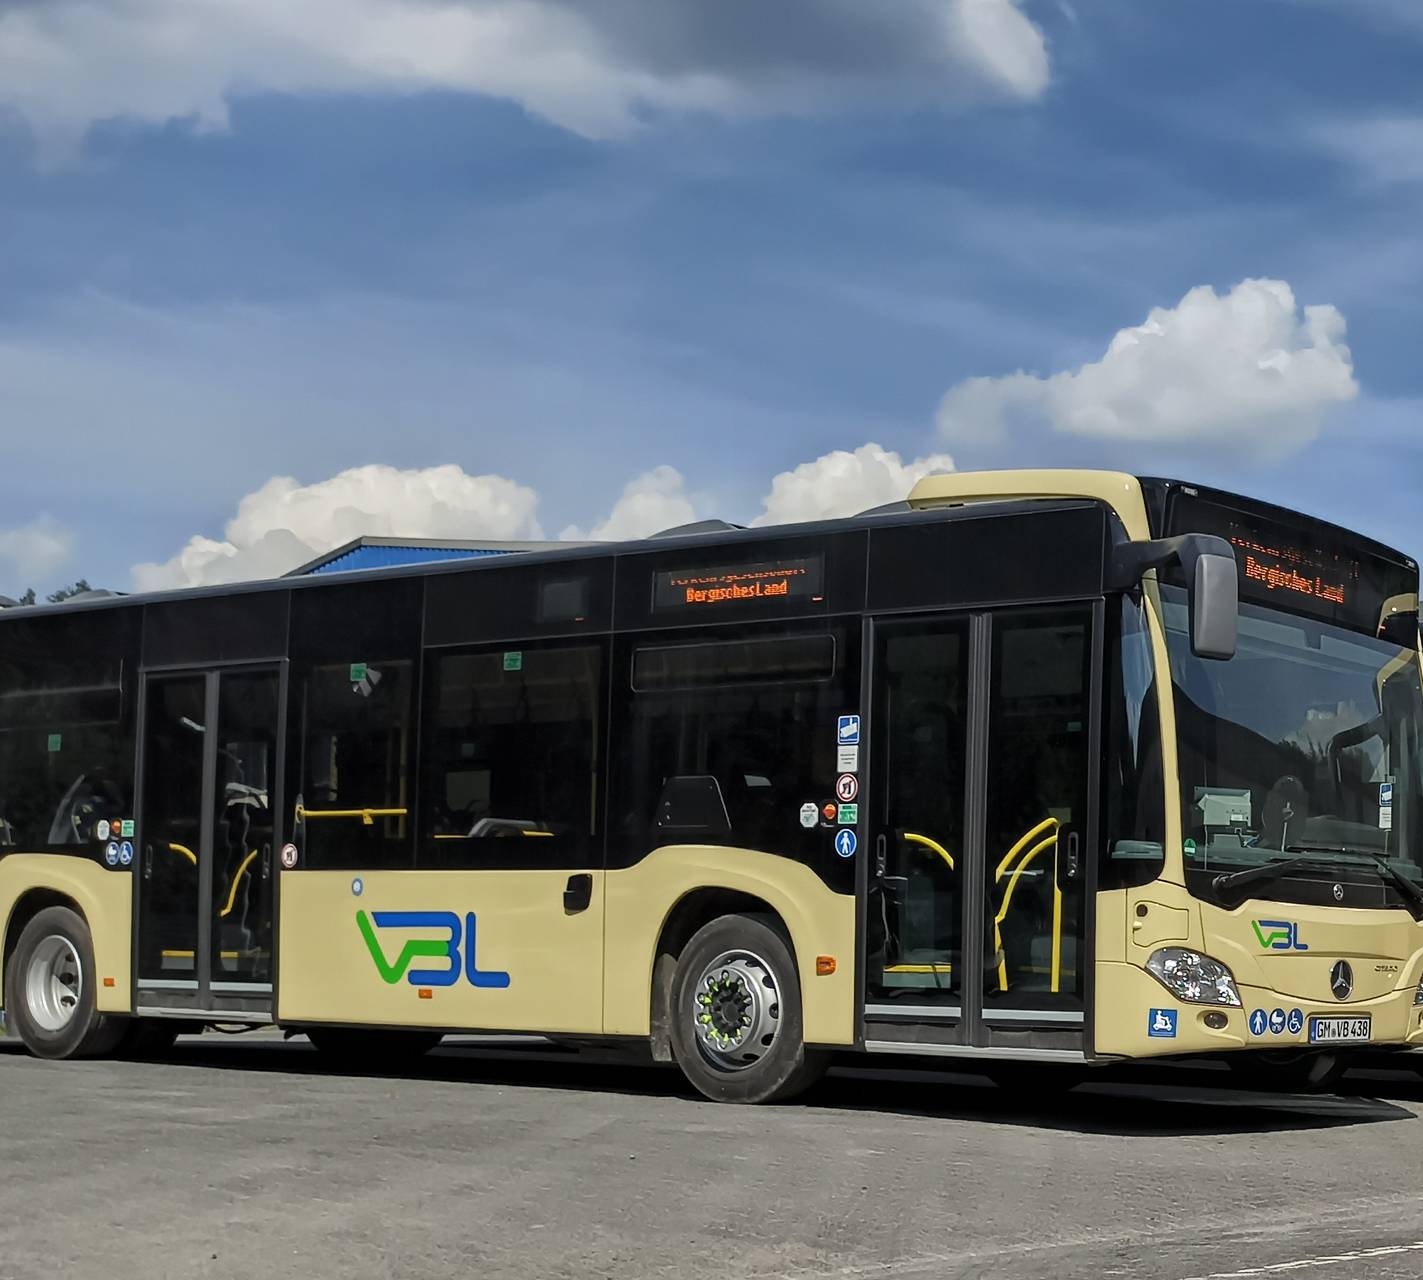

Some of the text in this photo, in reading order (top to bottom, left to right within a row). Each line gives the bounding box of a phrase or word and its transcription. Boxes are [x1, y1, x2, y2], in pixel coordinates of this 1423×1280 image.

[686, 578, 788, 603] Bergisches Land
[1245, 555, 1345, 604] Bergisches Land
[355, 909, 511, 988] VBL
[1251, 919, 1308, 950] VBL
[1317, 1020, 1368, 1038] GM VB 438
